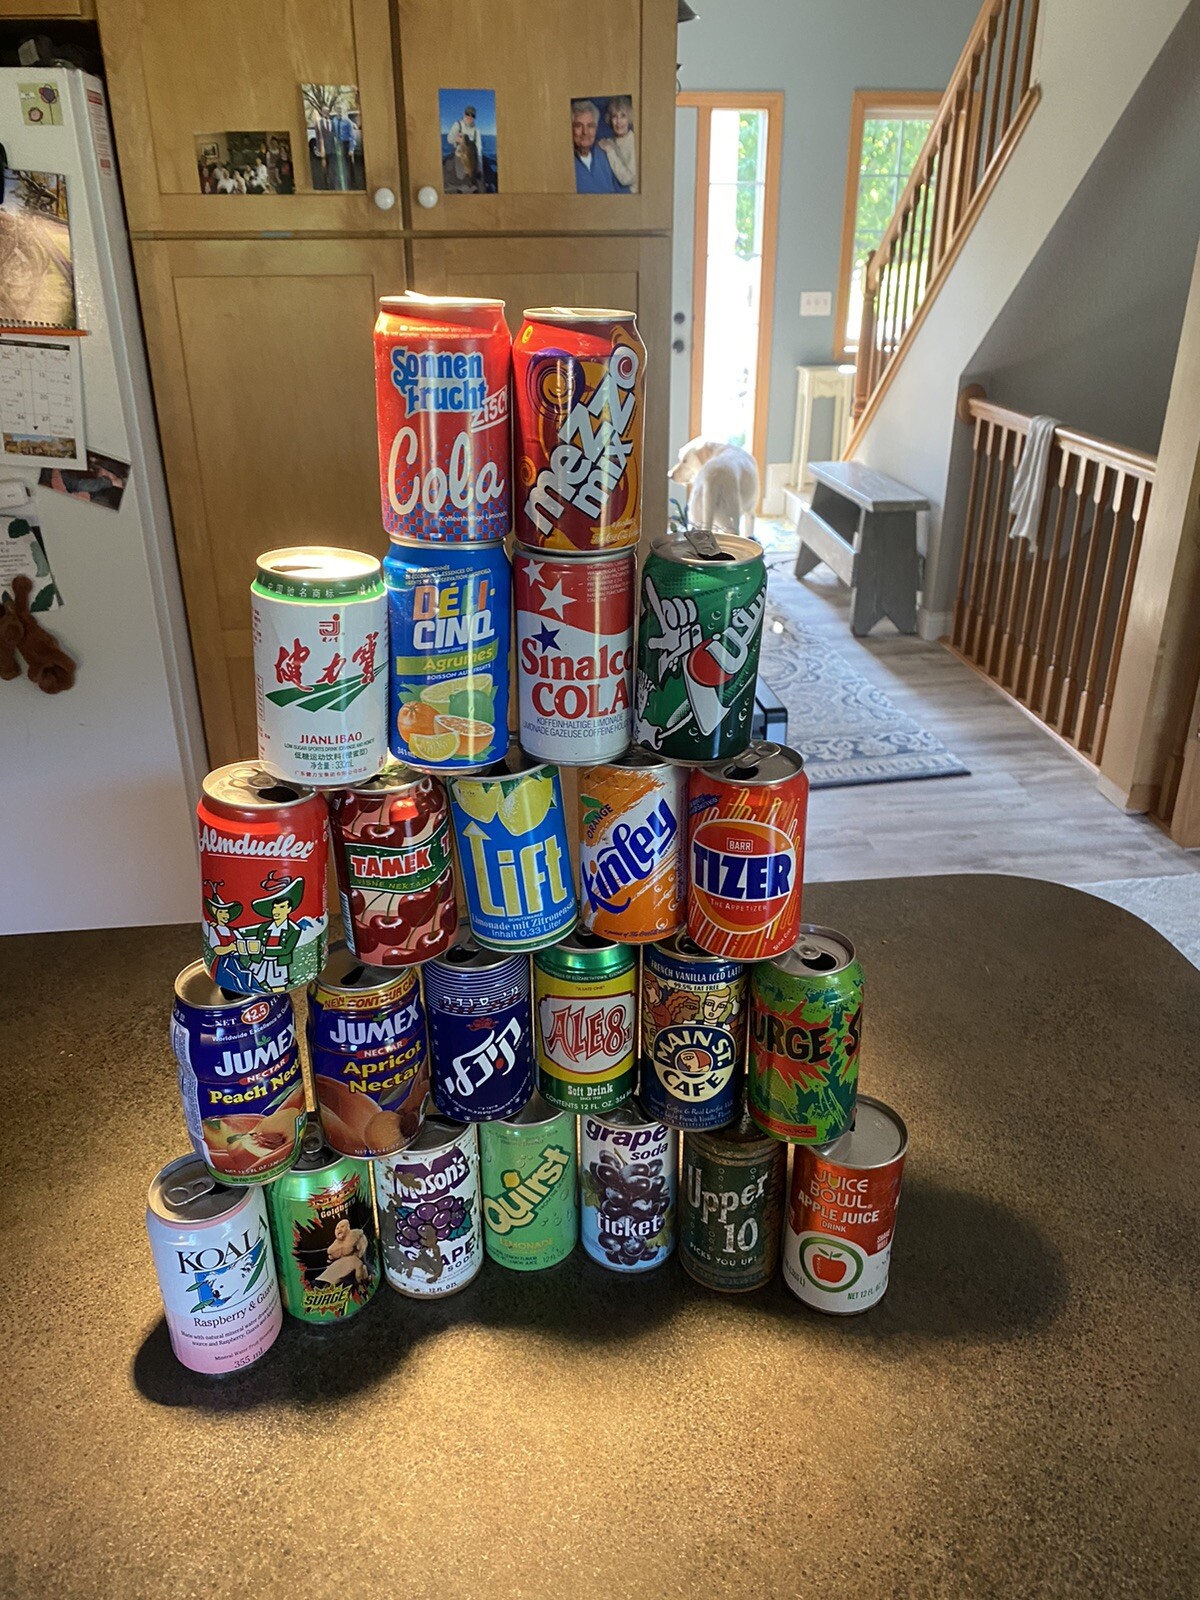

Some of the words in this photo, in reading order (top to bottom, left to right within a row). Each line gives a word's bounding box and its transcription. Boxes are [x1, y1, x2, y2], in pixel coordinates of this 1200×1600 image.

[391, 346, 483, 386] Sonnen
[404, 379, 488, 418] Frucht
[388, 426, 504, 515] Cola
[413, 609, 495, 650] CINQ
[423, 647, 494, 672] Agrumes
[427, 672, 456, 681] BOISSON
[532, 677, 630, 719] COLA
[537, 716, 591, 729] KOFFEINHALTIGE
[550, 728, 582, 738] GAZEUSE
[300, 731, 363, 745] JIANLIBAO
[586, 803, 614, 840] ORANGE
[199, 824, 318, 860] Almdudler
[728, 840, 751, 851] BARR
[350, 844, 433, 879] TAMEK
[462, 821, 568, 917] Lift
[693, 839, 792, 900] TIZER
[471, 912, 511, 930] Limonade
[512, 921, 529, 931] mit
[492, 929, 517, 938] Inhalt
[543, 919, 561, 932] Liter
[650, 960, 673, 977] FRENCH
[675, 971, 706, 982] VANILLA
[709, 971, 725, 982] ICED
[244, 1004, 267, 1022] 12.5
[323, 996, 345, 1008] NEW
[330, 994, 419, 1046] JUMEX
[212, 1032, 248, 1043] Worldwide
[214, 1021, 297, 1077] JUMEX
[364, 1040, 403, 1058] NECTAR
[656, 1030, 713, 1065] MAIN
[712, 1038, 732, 1067] ST.
[751, 1008, 832, 1064] URGE
[247, 1058, 287, 1083] NECTAR
[343, 1039, 423, 1078] Apricot
[349, 1060, 420, 1094] Nectar
[567, 1085, 583, 1097] Soft
[586, 1083, 613, 1097] Drink
[663, 1069, 724, 1097] CAFE
[209, 1085, 268, 1105] Peach
[545, 1093, 578, 1109] CONTENTS
[586, 1118, 669, 1152] grape
[630, 1142, 668, 1161] soda
[484, 1144, 571, 1236] Quirst
[687, 1164, 769, 1225] Upper
[810, 1180, 867, 1209] BOWL
[814, 1170, 869, 1193] JUICE
[798, 1190, 838, 1221] APPLE
[840, 1210, 880, 1225] JUICE
[596, 1210, 661, 1238] ticket
[722, 1217, 759, 1254] 10
[822, 1220, 847, 1233] DRINK
[176, 1215, 268, 1275] KOALA
[690, 1241, 711, 1260] PICKS
[715, 1257, 736, 1266] YOU
[304, 1289, 349, 1306] SURGE
[848, 1291, 859, 1300] NET
[194, 1307, 247, 1329] Raspberry
[248, 1300, 257, 1312] &
[206, 1331, 224, 1340] natural
[225, 1325, 244, 1338] mineral
[215, 1353, 233, 1361] Mineral
[234, 1346, 248, 1356] Water
[234, 1355, 251, 1369] 355
